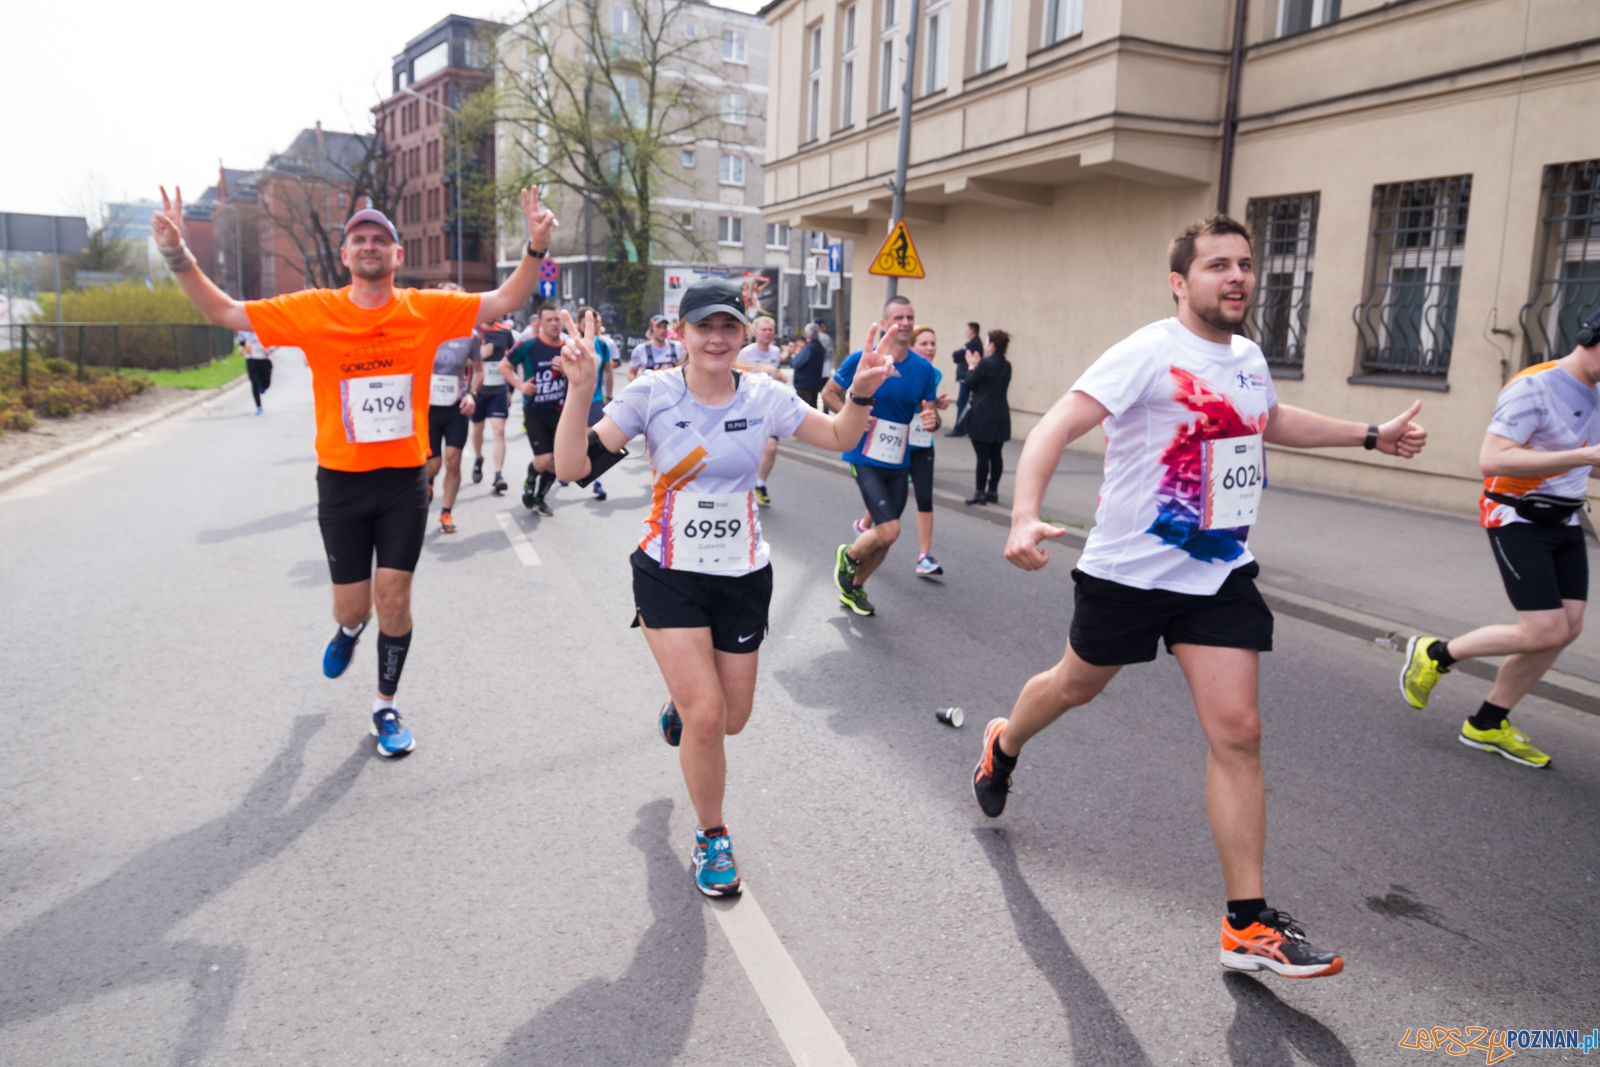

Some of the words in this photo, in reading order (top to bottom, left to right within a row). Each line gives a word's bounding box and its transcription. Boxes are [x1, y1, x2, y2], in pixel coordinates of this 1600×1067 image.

[340, 357, 393, 373] GORZÓW
[362, 396, 405, 413] 4196
[1223, 463, 1262, 489] 6024
[684, 519, 741, 539] 6959
